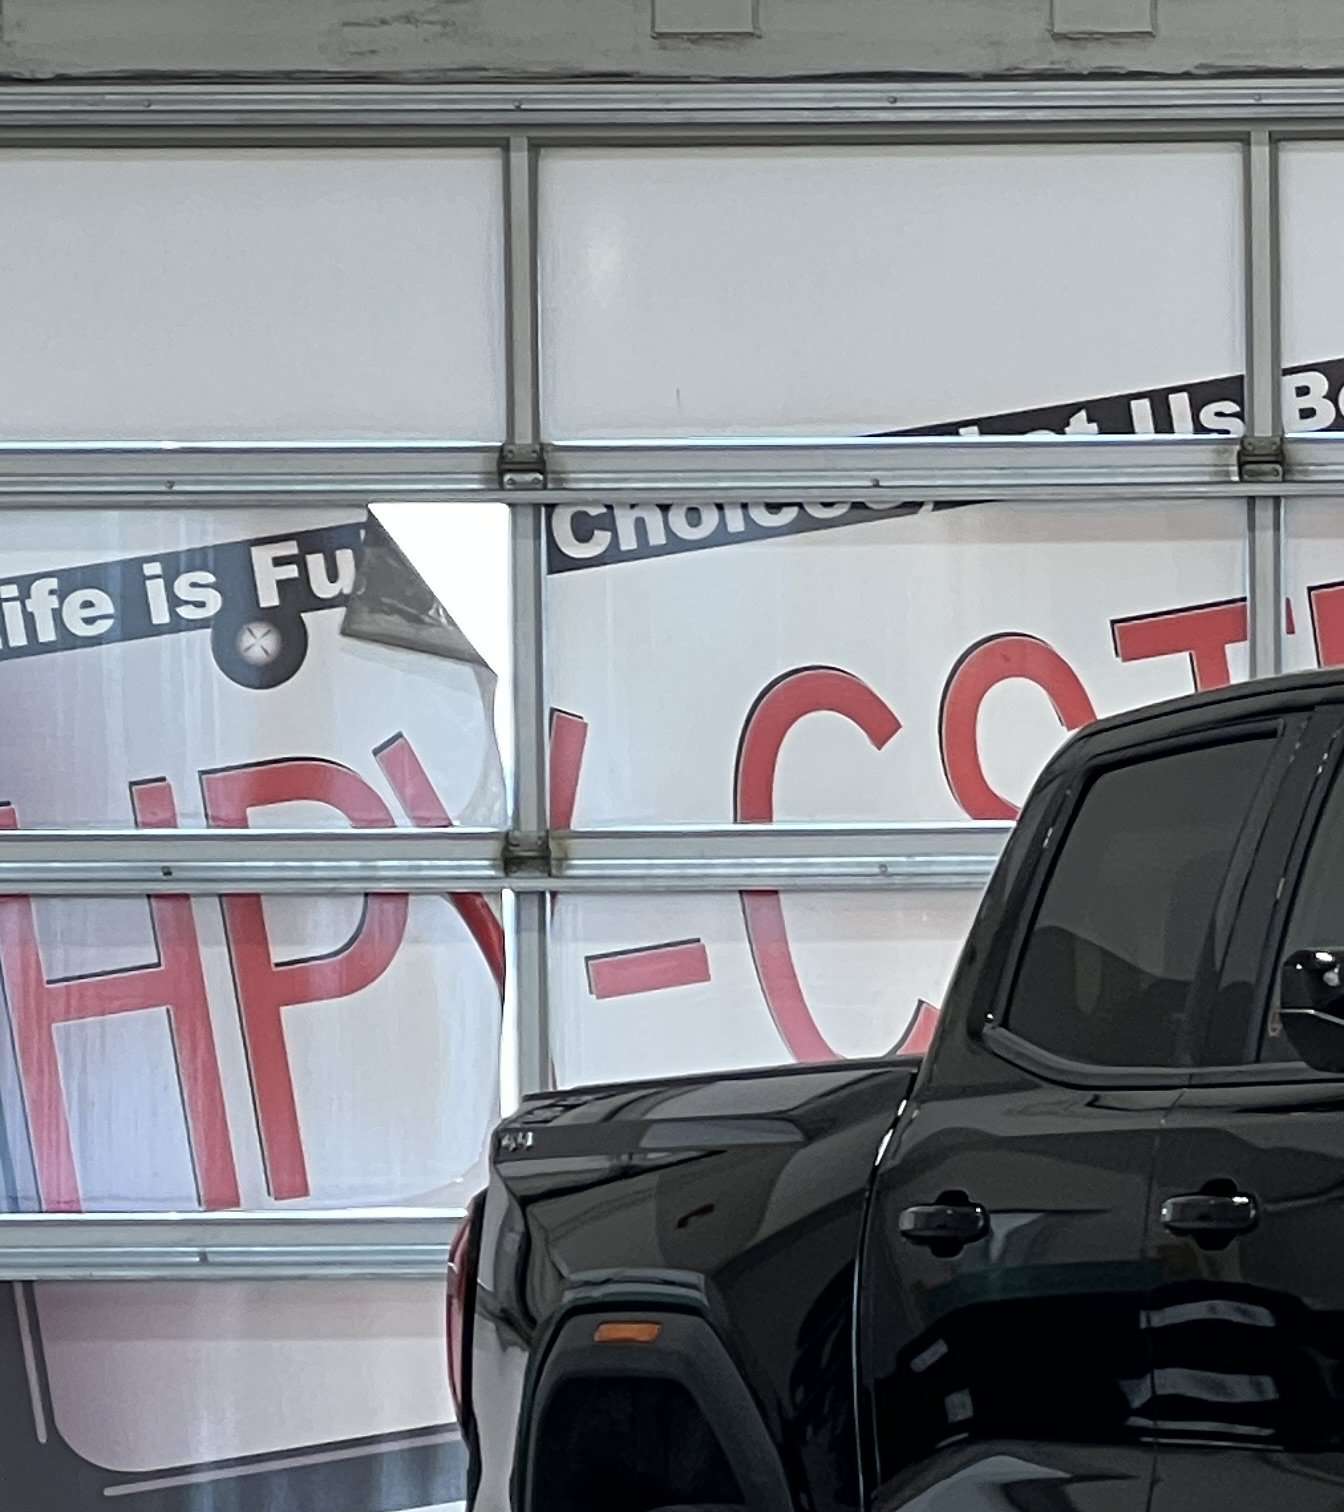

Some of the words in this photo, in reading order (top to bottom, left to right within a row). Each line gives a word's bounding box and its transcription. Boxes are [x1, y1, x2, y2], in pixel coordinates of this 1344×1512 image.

[0, 560, 115, 649] ife
[142, 561, 223, 625] is
[250, 530, 366, 608] Fu
